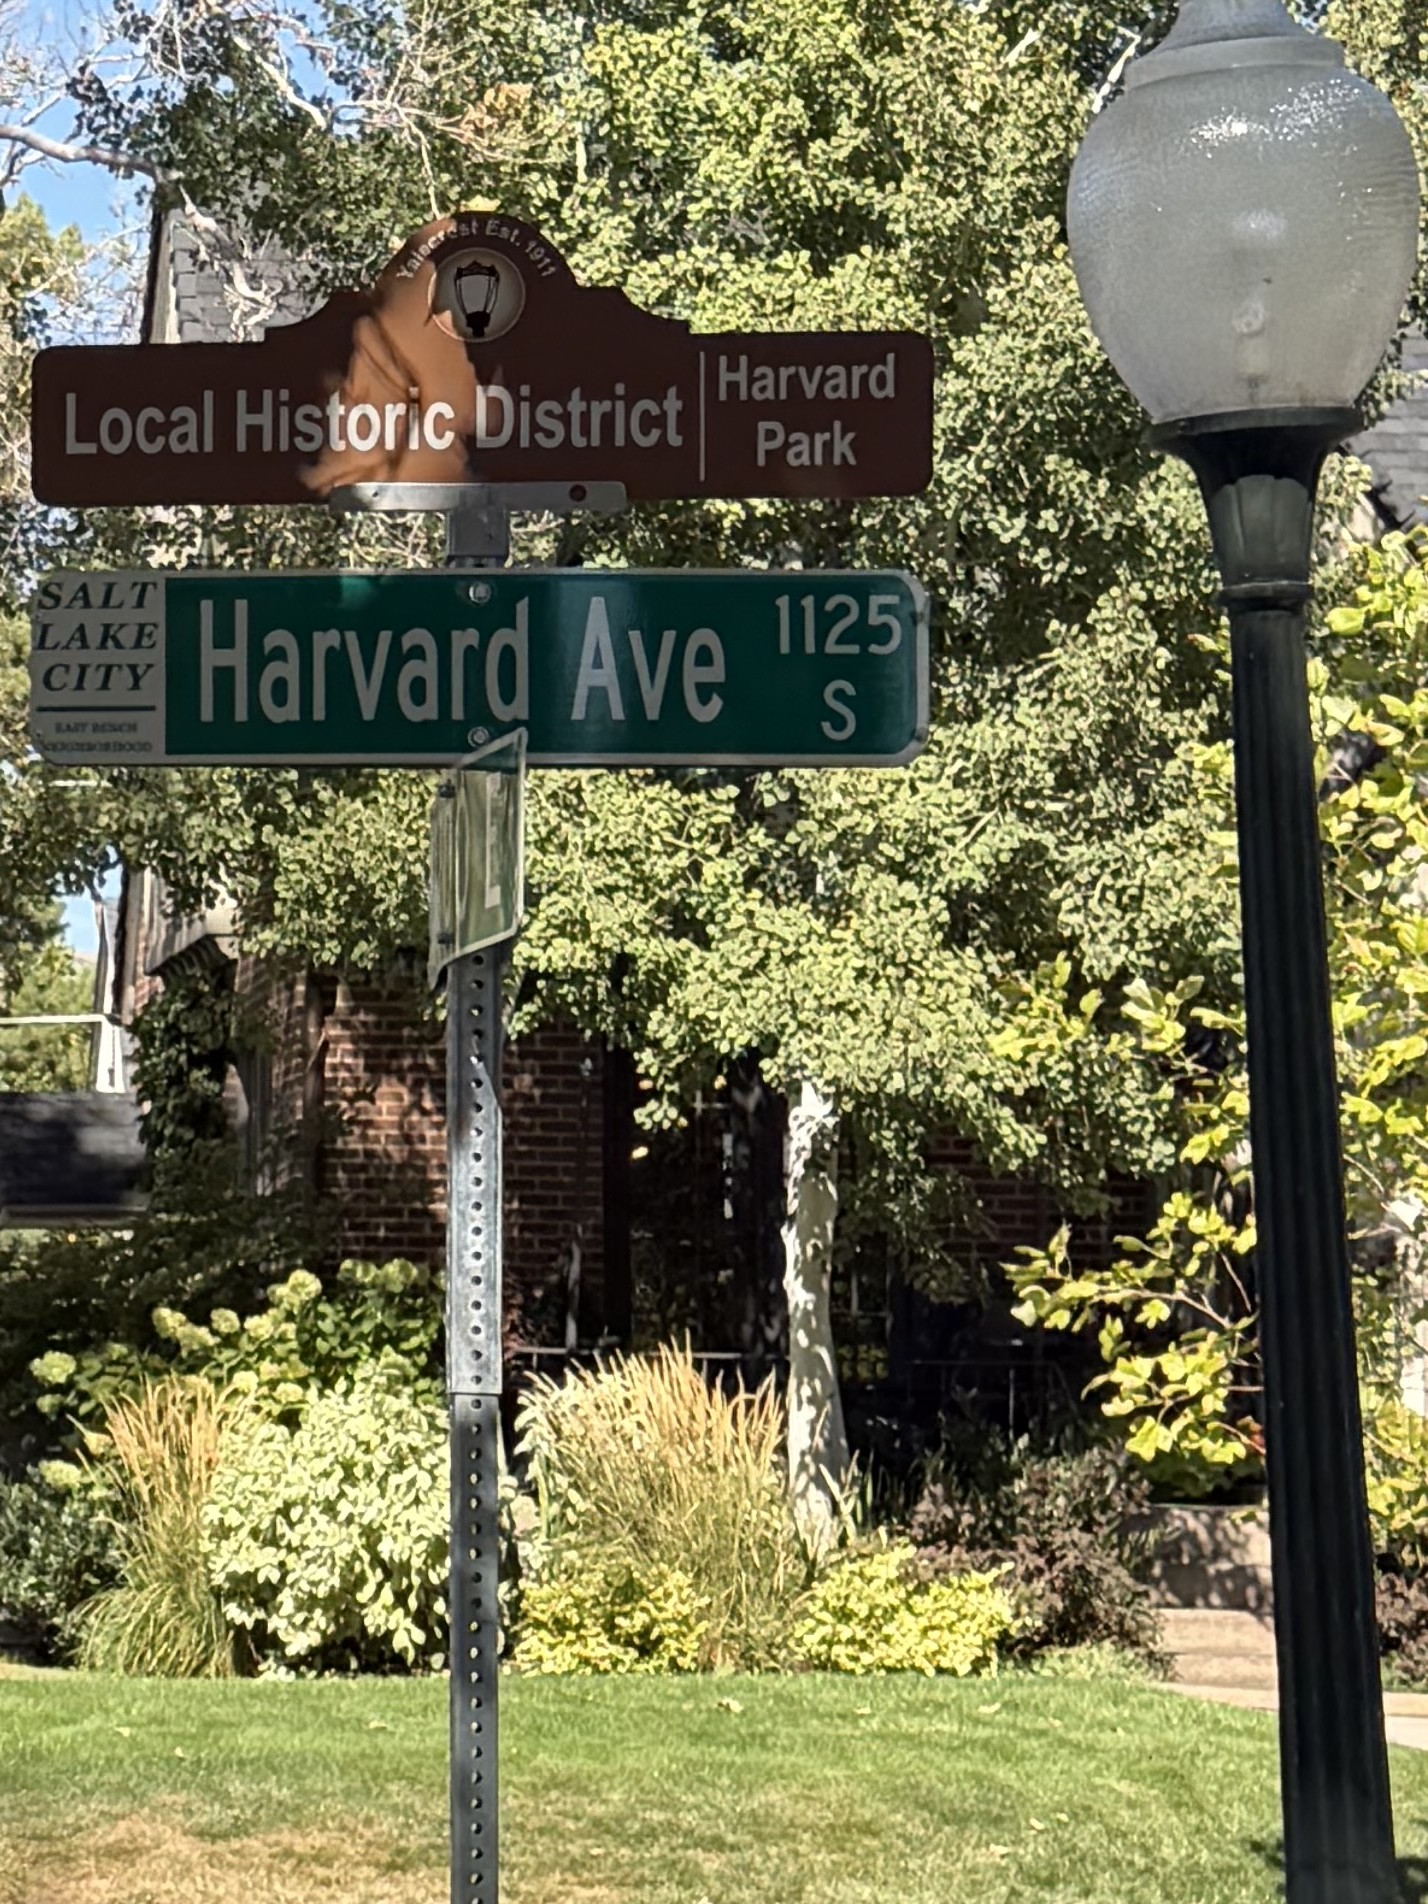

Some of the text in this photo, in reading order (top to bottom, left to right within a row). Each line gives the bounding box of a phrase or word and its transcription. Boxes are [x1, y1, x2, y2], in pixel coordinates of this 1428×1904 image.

[396, 217, 557, 279] Yalecrest Est. 1911
[717, 352, 896, 402] Harvard
[64, 382, 684, 455] Local Historic District
[756, 419, 858, 468] Park
[36, 581, 158, 610] SALT
[34, 622, 159, 651] LAKE
[775, 594, 902, 655] 1125
[41, 662, 155, 692] CITY
[200, 596, 726, 724] Harvard Ave
[820, 679, 857, 741] S
